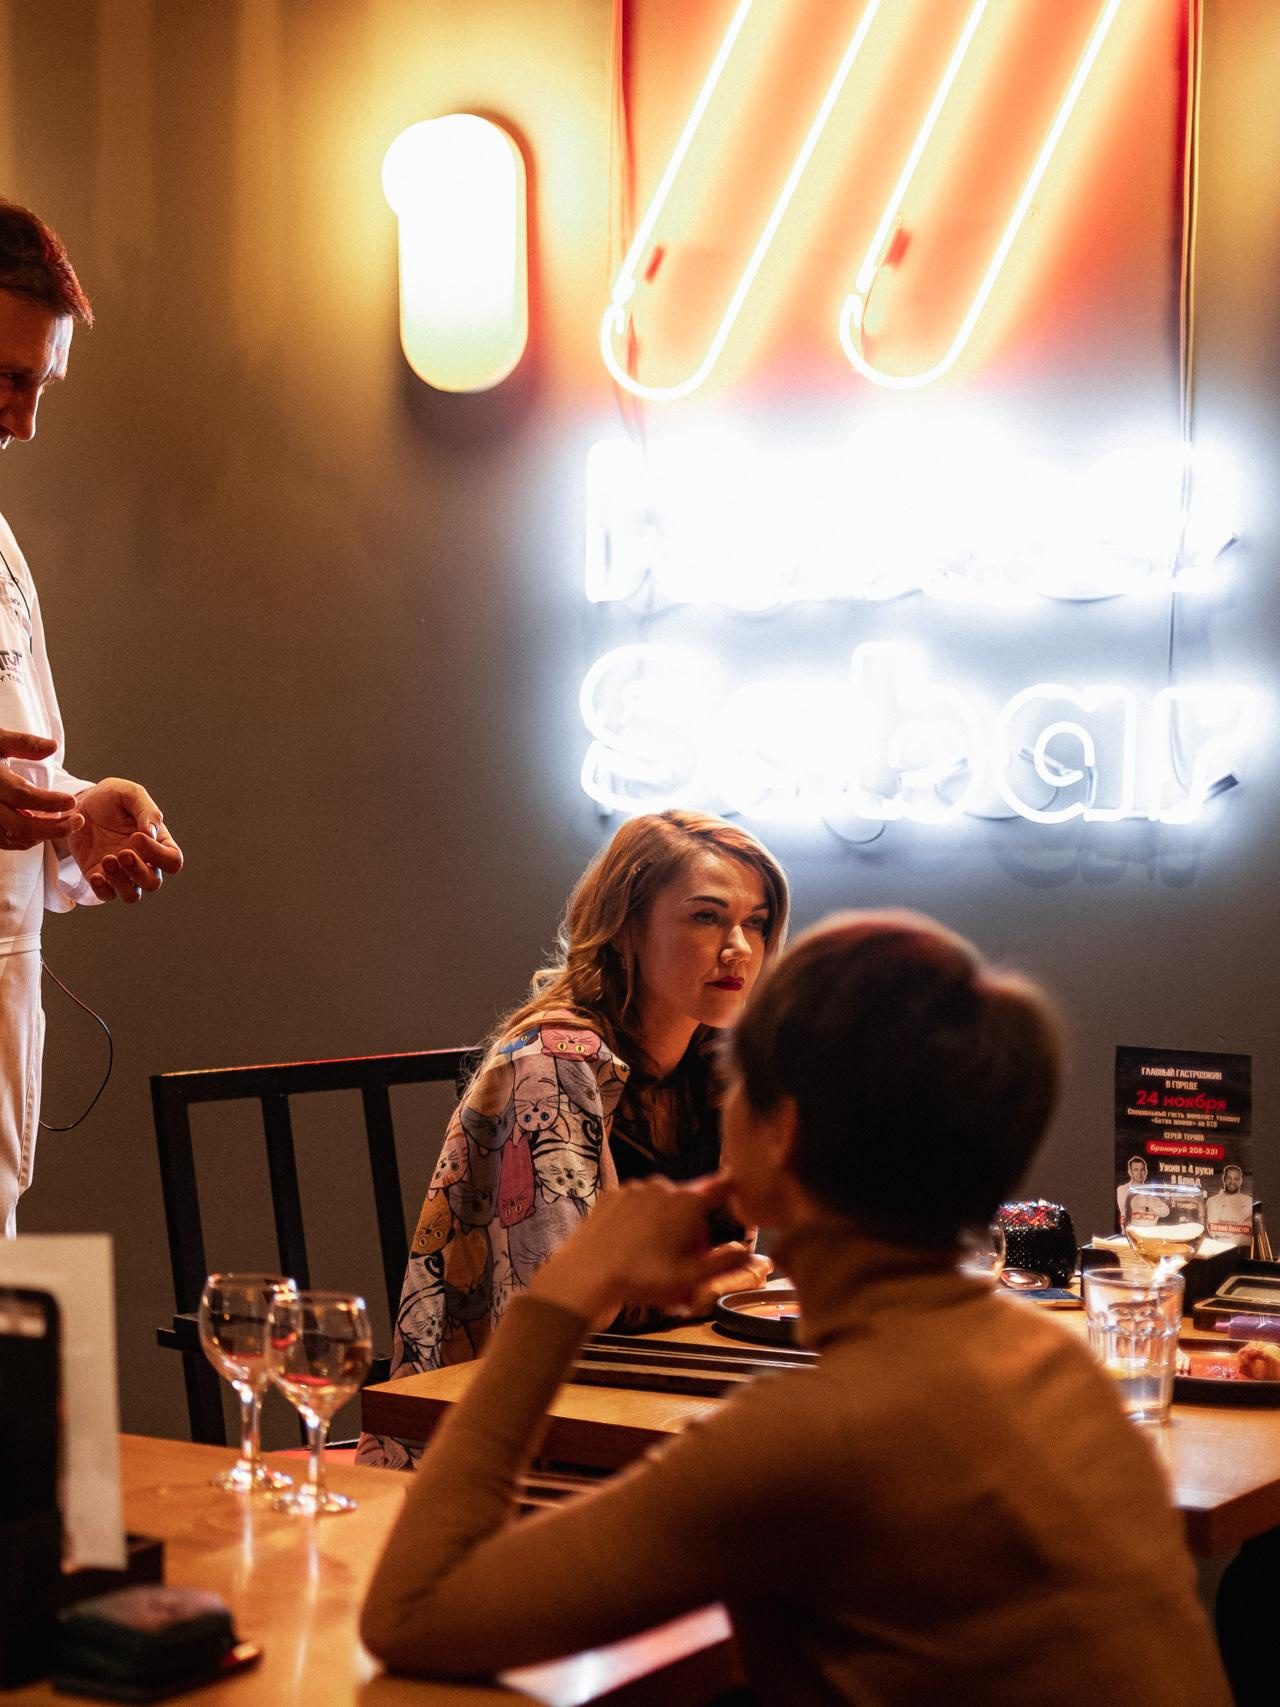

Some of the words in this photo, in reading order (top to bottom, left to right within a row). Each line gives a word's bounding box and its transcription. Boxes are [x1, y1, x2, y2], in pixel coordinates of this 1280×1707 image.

[1141, 1067, 1175, 1077] ГЛАВНЫЙ
[1176, 1069, 1223, 1081] ГАСТРОУЖИН
[1165, 1080, 1171, 1089] В
[1172, 1081, 1199, 1090] ГОРОДЕ
[1136, 1090, 1159, 1106] 24
[1163, 1093, 1227, 1112] ноября
[1150, 1144, 1188, 1154] бронируй
[1159, 1161, 1181, 1173] Ужин
[1181, 1165, 1187, 1173] в
[1188, 1164, 1194, 1174] 4
[1195, 1166, 1214, 1176] руки
